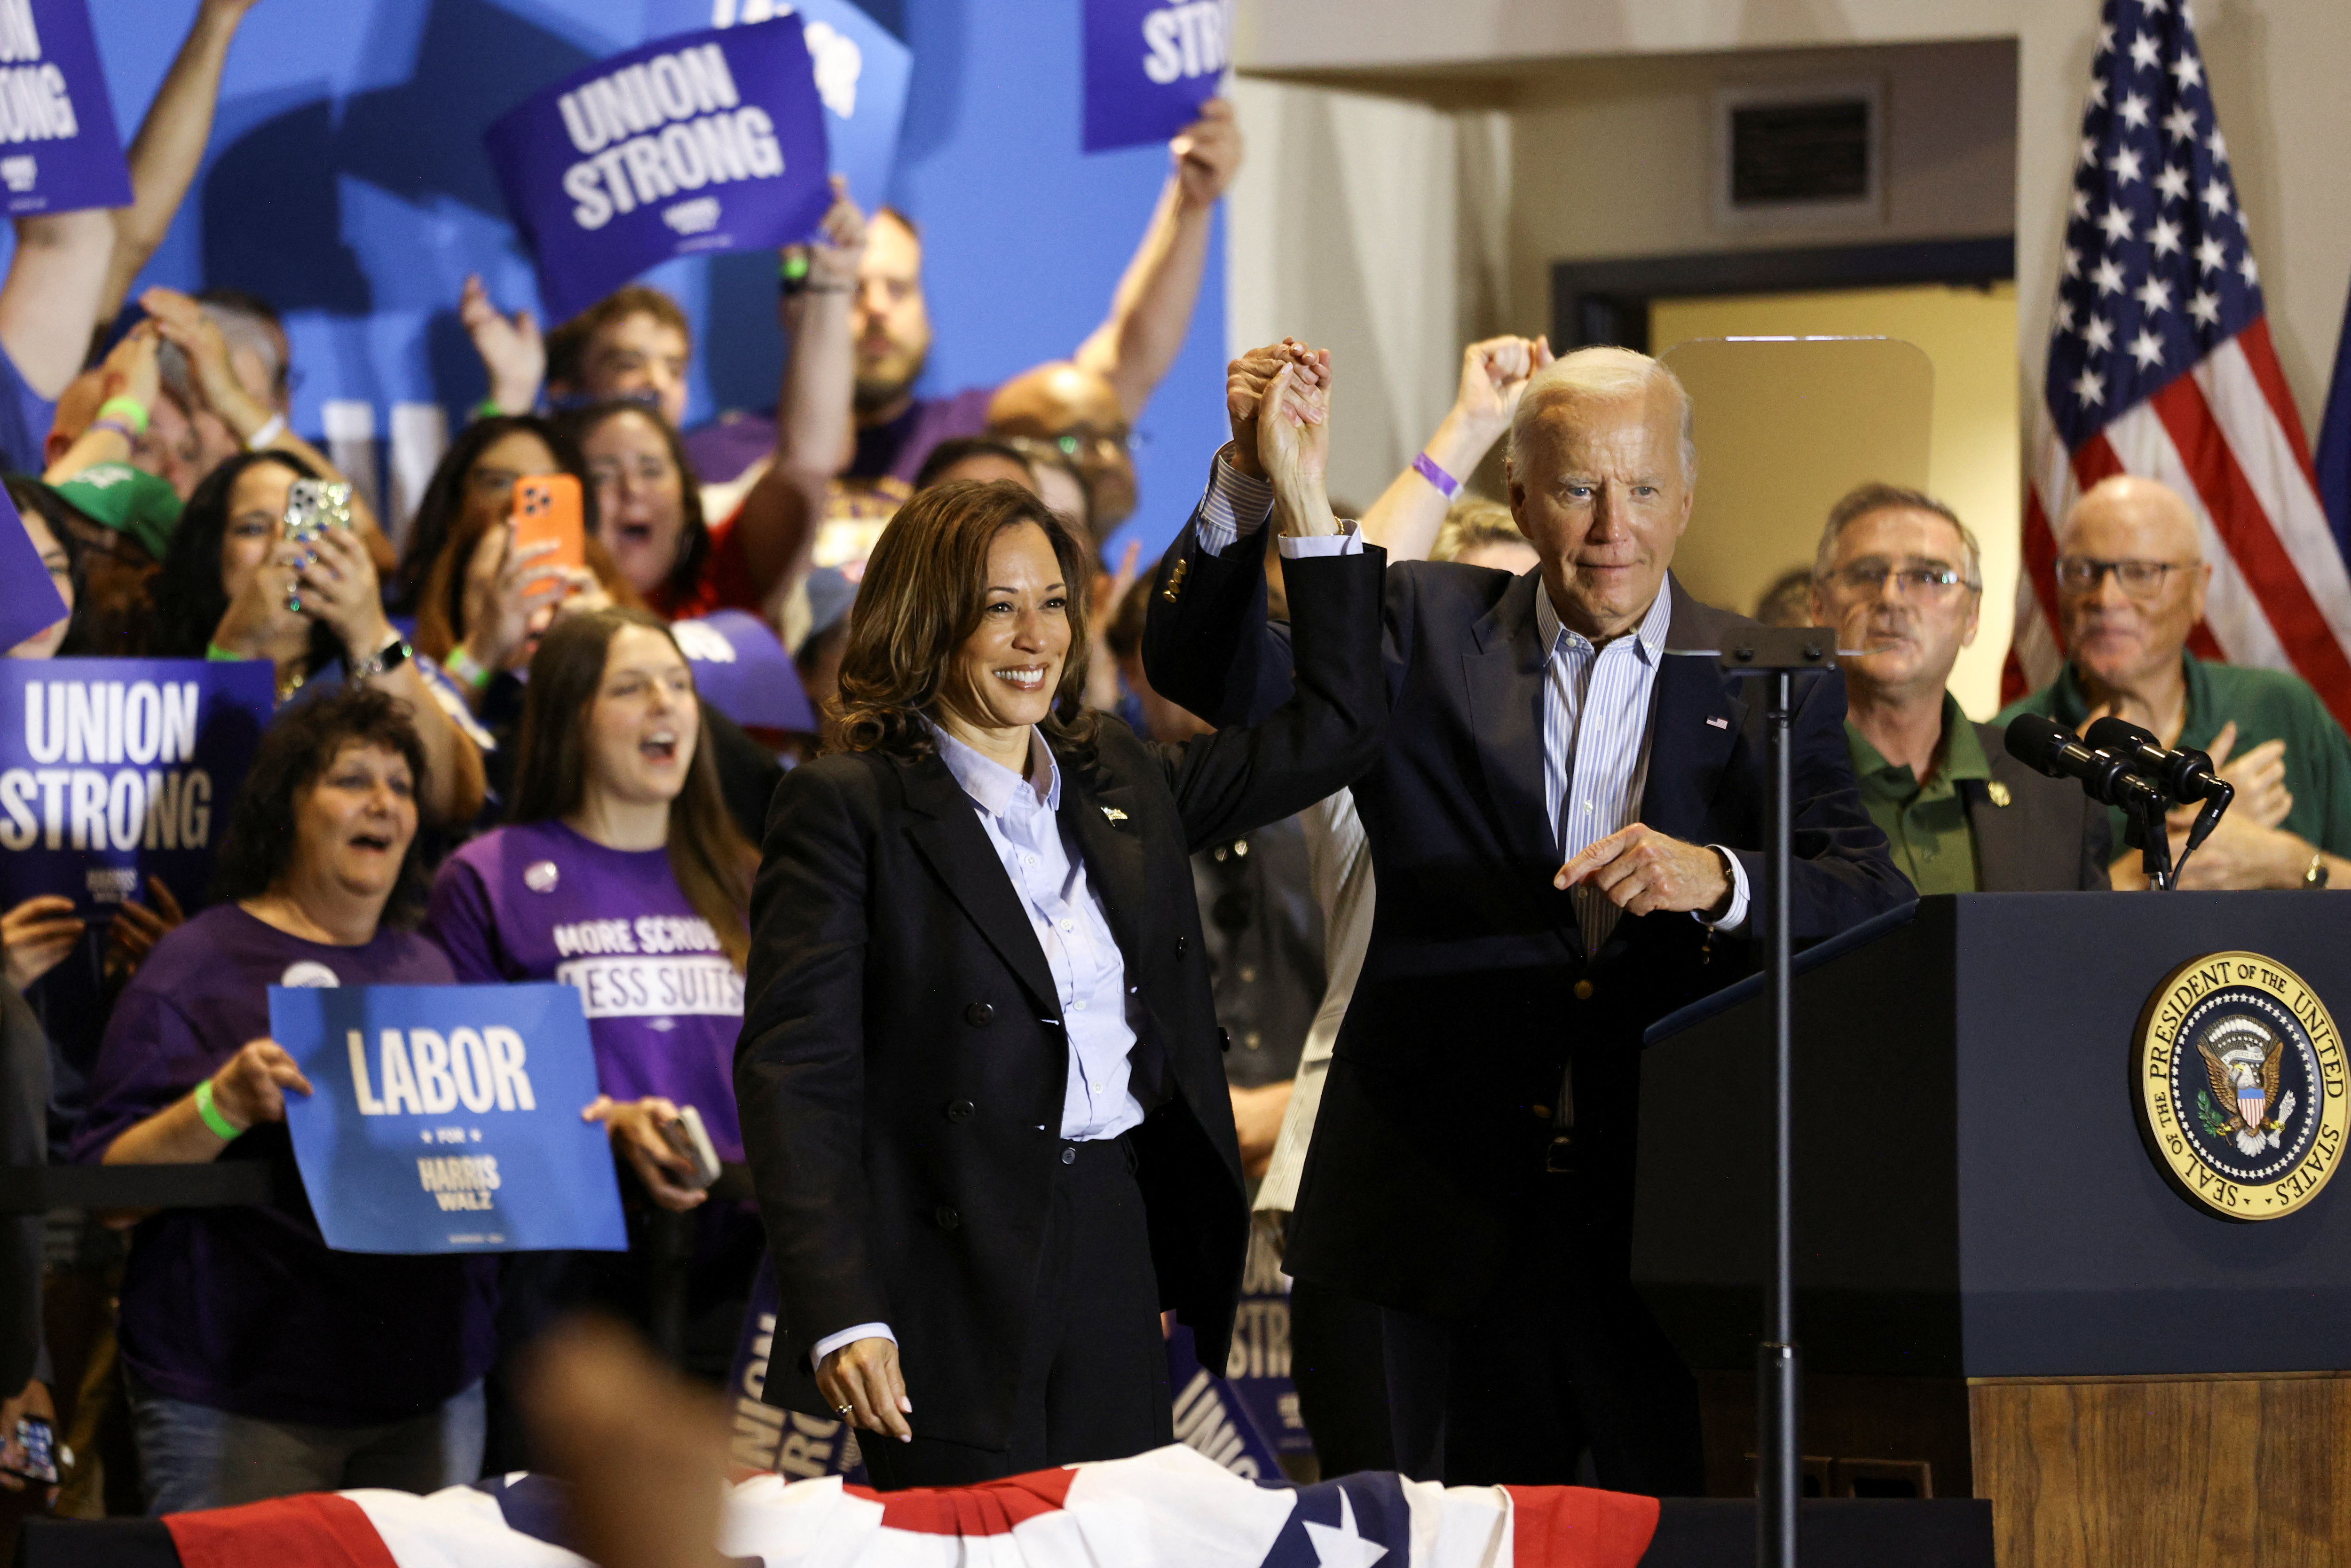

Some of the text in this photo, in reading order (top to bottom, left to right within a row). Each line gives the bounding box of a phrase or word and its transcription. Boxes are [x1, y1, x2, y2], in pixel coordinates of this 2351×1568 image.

[558, 43, 740, 154] UNION
[563, 106, 784, 230] STRONG
[25, 681, 199, 765] UNION
[0, 768, 213, 852] STRONG
[553, 918, 638, 957] MORE
[565, 968, 744, 1008] ESS SUITS
[347, 1026, 536, 1115] LABOR
[2150, 961, 2343, 1207] SEAL OF THE PRESIDENT OF THE UNITED STATES
[417, 1154, 501, 1192] HARRIS
[435, 1191, 493, 1212] WALZ
